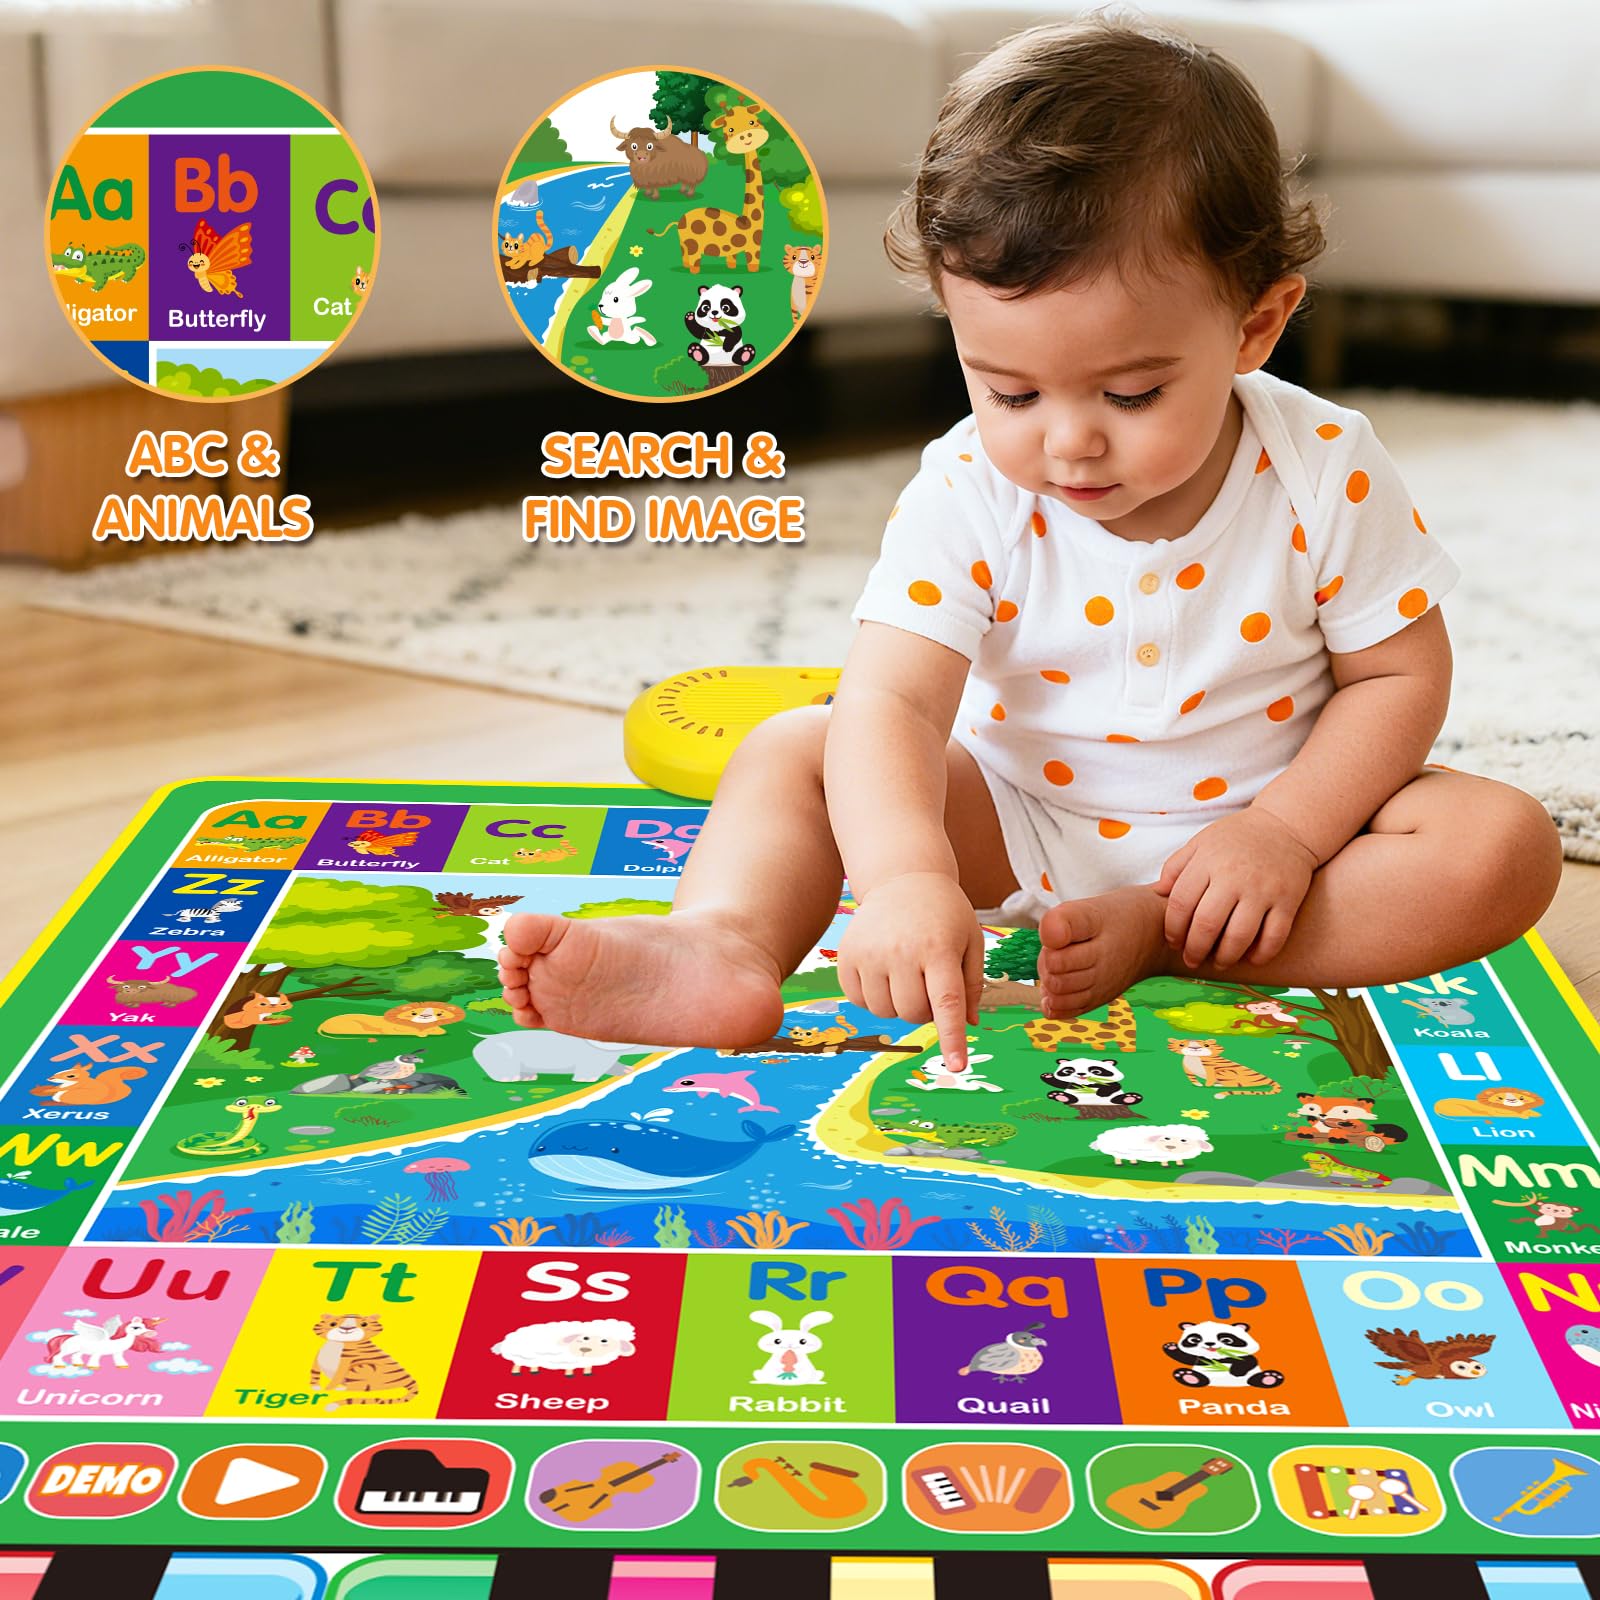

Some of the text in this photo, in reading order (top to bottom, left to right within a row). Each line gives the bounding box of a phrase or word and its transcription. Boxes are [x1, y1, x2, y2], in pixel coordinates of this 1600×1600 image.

[211, 809, 308, 830] Aa
[346, 809, 431, 829] Bb
[485, 819, 566, 839] Cc
[185, 854, 287, 865] Alligator
[317, 858, 420, 870] Butterfly
[469, 857, 511, 865] Cat
[173, 873, 264, 895] Zz
[148, 926, 226, 937] Zebra
[132, 945, 219, 978] Yy
[109, 1012, 156, 1023] Yak
[1413, 1027, 1491, 1039] Koala
[49, 1033, 166, 1063] Xx
[22, 1108, 110, 1121] Xerus
[1472, 1126, 1536, 1139] Lion
[1458, 1153, 1600, 1189] Mm
[82, 1257, 231, 1301] Uu
[313, 1261, 418, 1303] Tt
[520, 1260, 631, 1303] Ss
[749, 1260, 847, 1301] Rr
[926, 1265, 1069, 1319] Qq
[1143, 1267, 1268, 1320] Pp
[1342, 1269, 1485, 1312] Oo
[1518, 1272, 1600, 1313] N
[16, 1387, 164, 1407] Unicorn
[234, 1388, 329, 1409] Tiger
[494, 1392, 610, 1414] Sheep
[728, 1395, 847, 1414] Rabbit
[957, 1396, 1051, 1416] Quail
[1178, 1398, 1291, 1417] Panda
[1425, 1401, 1496, 1418] Owl
[39, 1463, 165, 1497] DEMO
